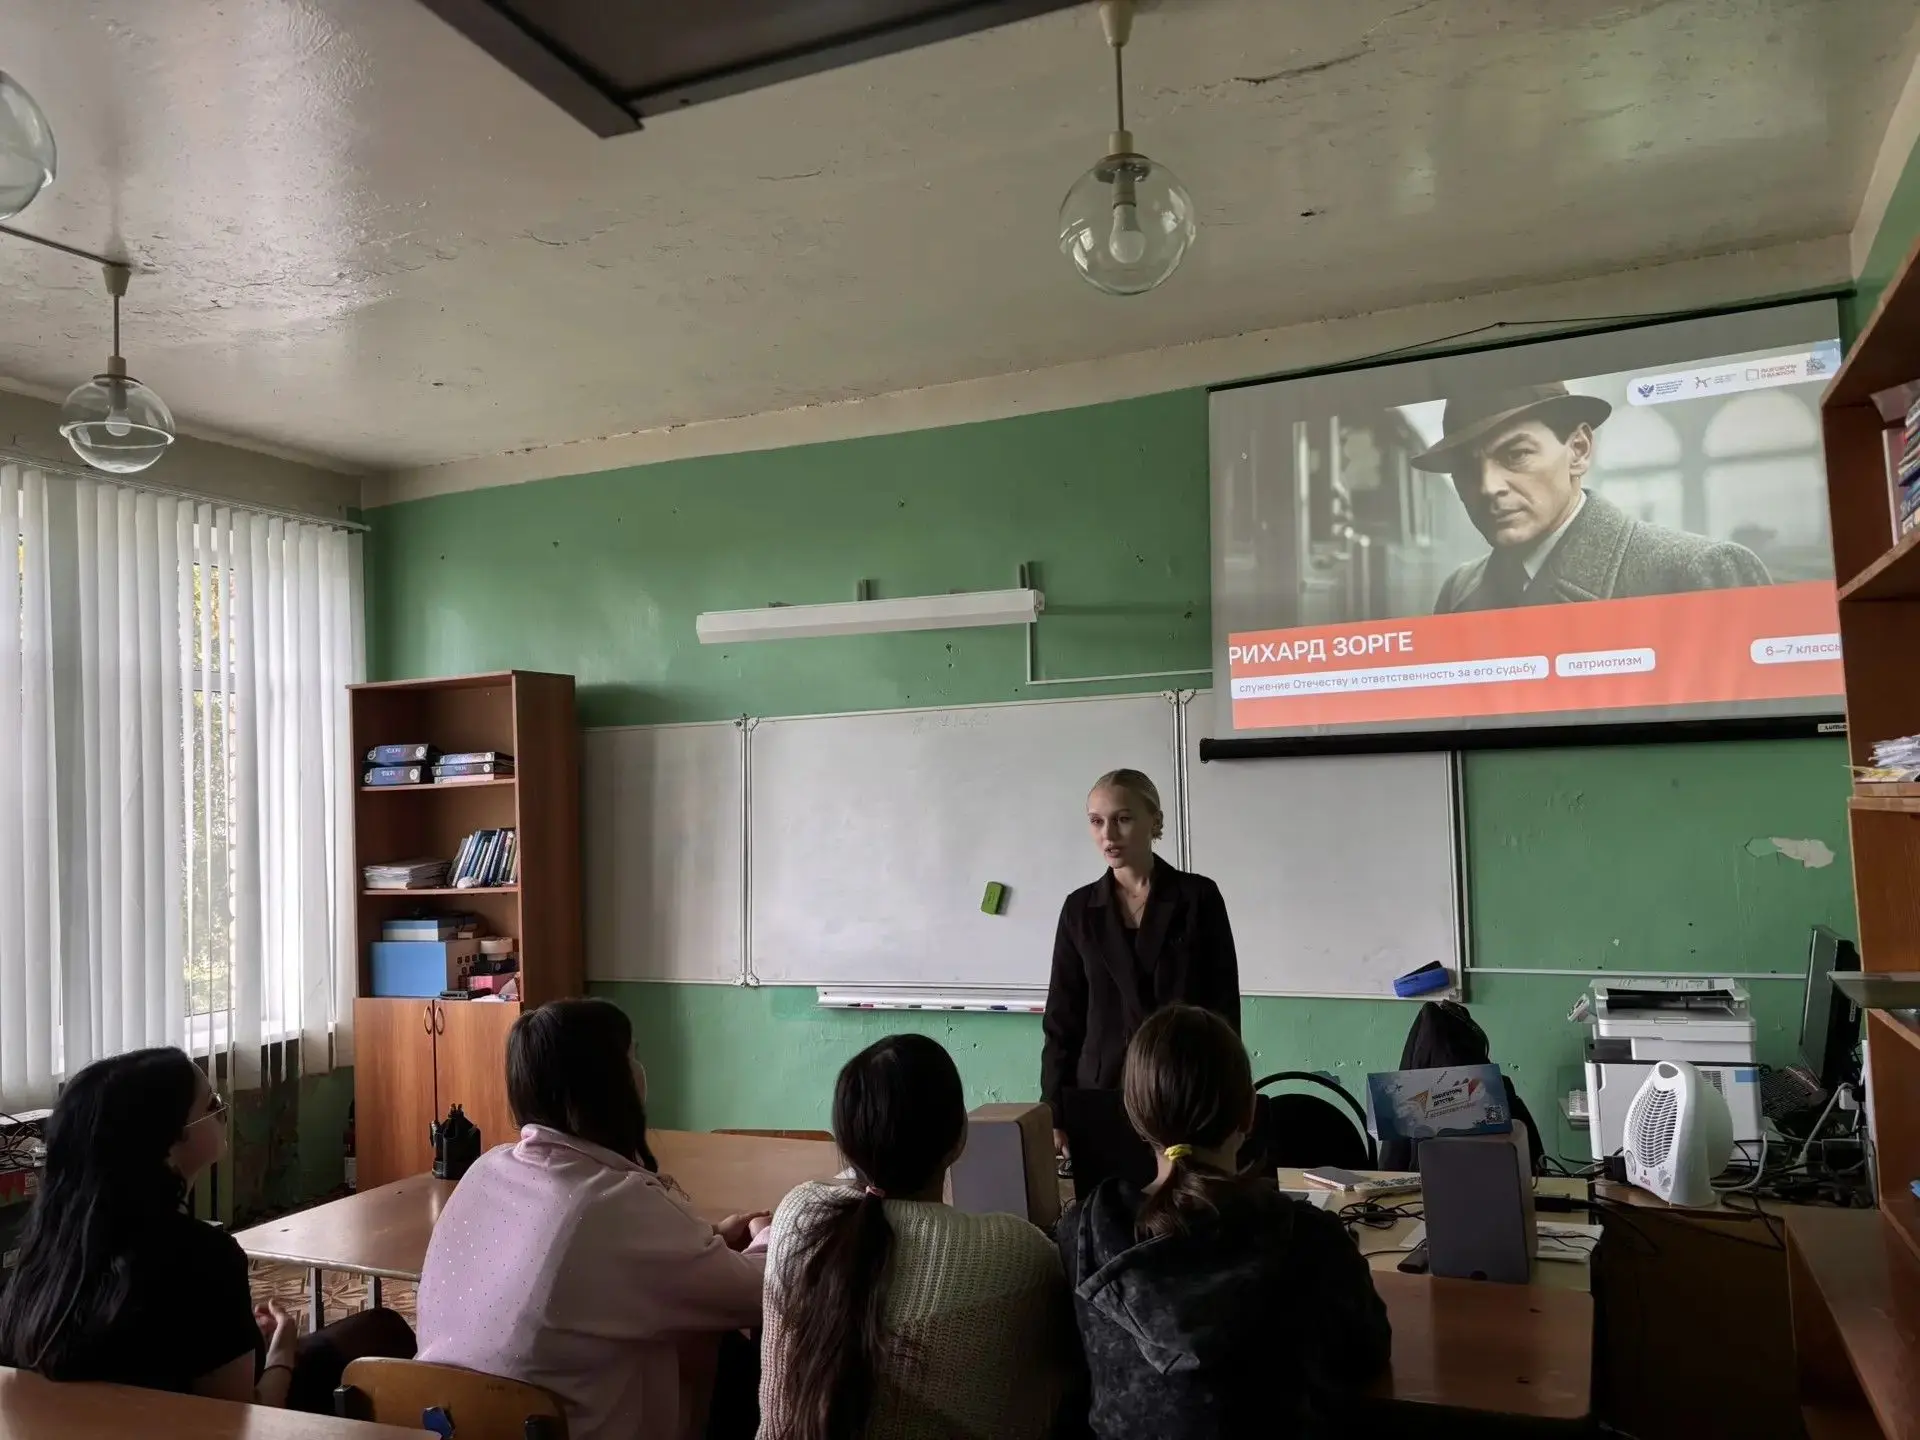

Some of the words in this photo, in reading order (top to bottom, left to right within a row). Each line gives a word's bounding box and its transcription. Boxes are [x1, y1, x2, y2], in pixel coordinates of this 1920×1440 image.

[1229, 639, 1326, 665] РИХАРД
[1333, 631, 1413, 656] ЗОРГЕ
[1568, 656, 1642, 670] патриотизм
[1239, 681, 1290, 694] служение
[1293, 676, 1348, 690] Отечеству
[1352, 677, 1358, 685] и
[1361, 669, 1454, 684] ответственность
[1457, 668, 1470, 677] за
[1474, 667, 1493, 677] его
[1496, 663, 1536, 676] судьбу
